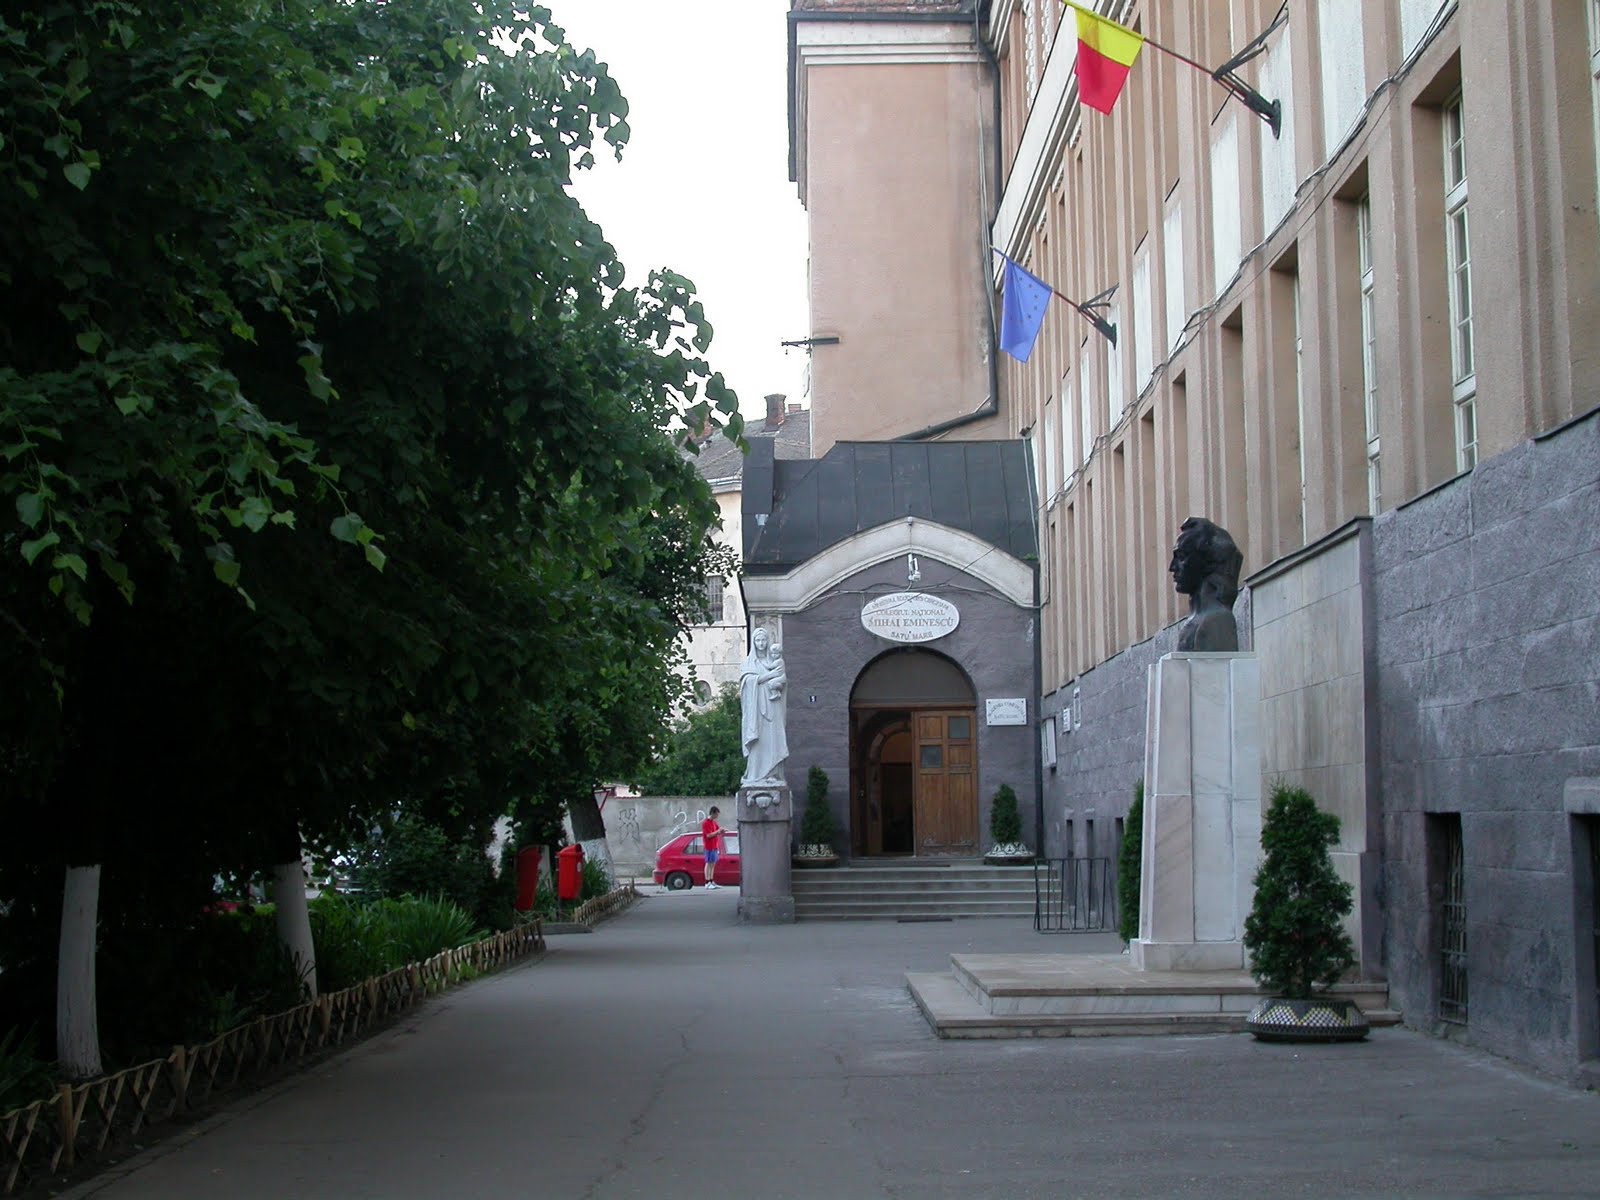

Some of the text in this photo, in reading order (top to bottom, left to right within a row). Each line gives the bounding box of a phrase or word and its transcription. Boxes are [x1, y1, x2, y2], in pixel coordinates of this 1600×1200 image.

[868, 618, 954, 627] MIHAI EMINESCU
[890, 631, 934, 640] SATU MARE
